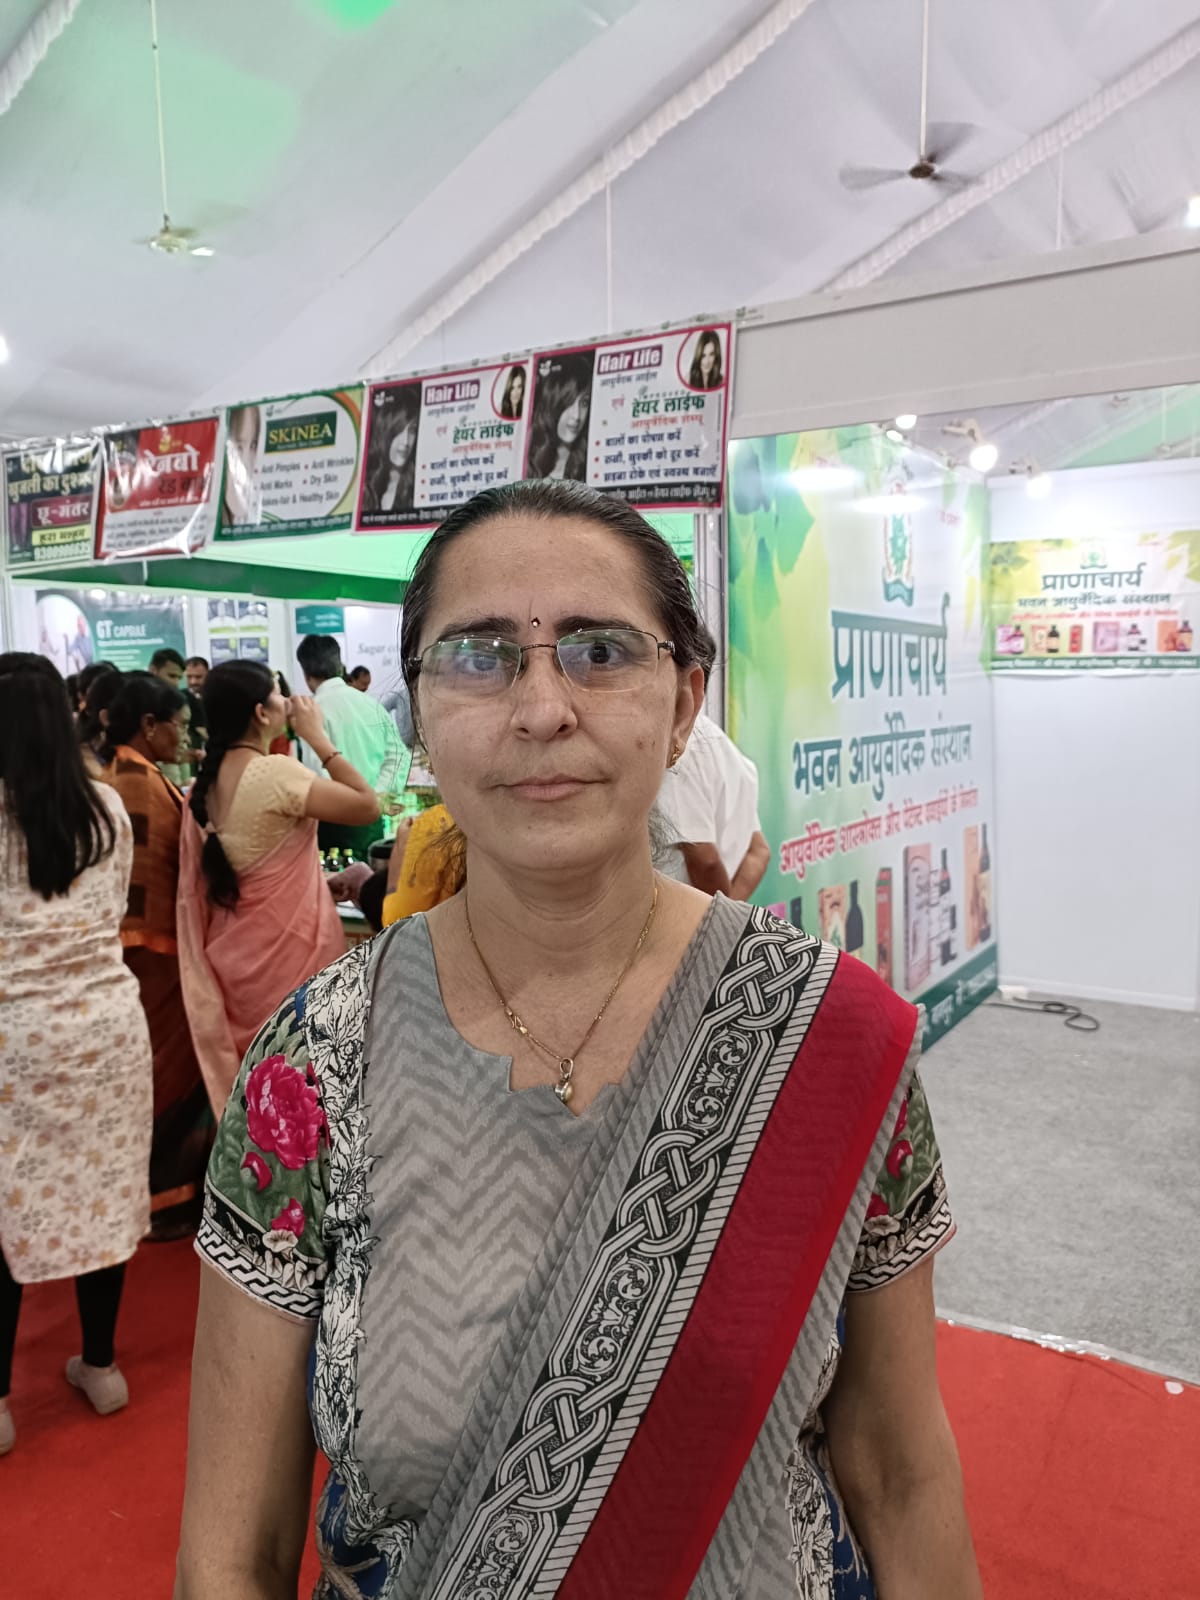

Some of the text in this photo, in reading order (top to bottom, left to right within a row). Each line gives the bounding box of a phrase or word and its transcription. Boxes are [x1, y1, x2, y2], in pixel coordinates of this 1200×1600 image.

[600, 347, 661, 374] Hair Life
[426, 382, 479, 404] Hair Life
[632, 398, 659, 418] हेयर
[268, 422, 333, 445] SKINEA
[453, 426, 476, 445] हेयर
[627, 433, 639, 445] का
[667, 427, 681, 441] करें
[656, 447, 668, 460] को
[670, 449, 682, 463] दूर
[684, 443, 700, 459] करें
[42, 475, 60, 492] का
[309, 473, 339, 488] Dry Skin
[325, 490, 340, 502] Skin
[1041, 562, 1147, 591] प्राणाचार्य
[1017, 590, 1171, 611] भवन आयुर्वेदिक संस्थान
[831, 592, 950, 699] प्राणाचार्य
[793, 711, 972, 801] भवन आयुर्वेदिक संस्थान
[780, 821, 837, 880] आयुर्वेदिक
[884, 802, 901, 837] और
